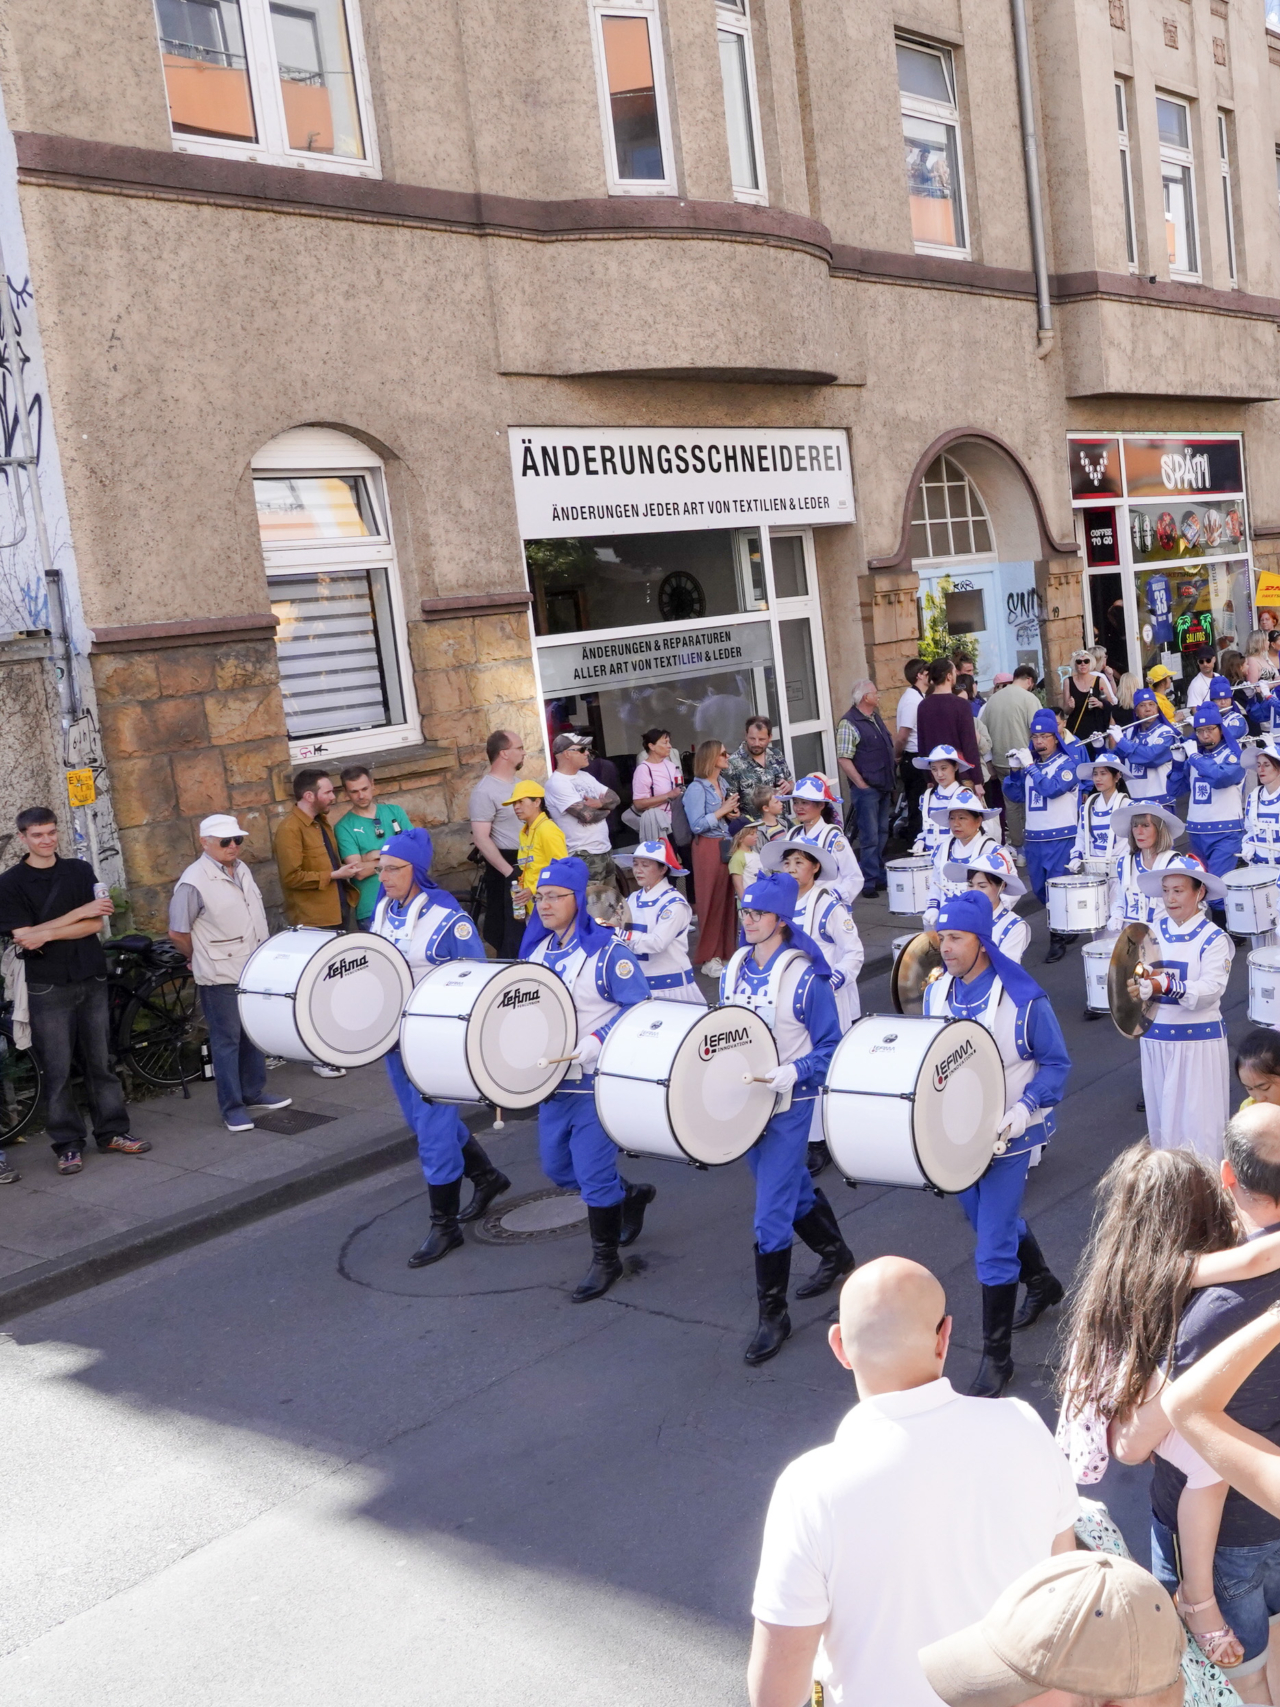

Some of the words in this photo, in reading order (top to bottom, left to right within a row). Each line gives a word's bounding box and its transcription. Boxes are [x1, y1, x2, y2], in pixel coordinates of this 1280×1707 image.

[522, 438, 842, 477] ÄNDERUNGSSCHNEIDEREI
[1160, 447, 1212, 490] SPÄTI
[552, 504, 640, 522] ÄNDERUNGEN
[642, 502, 680, 517] JEDER
[683, 501, 704, 516] ART
[708, 500, 731, 514] VON
[732, 498, 787, 512] TEXTILIEN
[789, 497, 796, 511] &
[798, 496, 830, 510] LEDER
[1090, 528, 1112, 537] COFFEE
[1092, 537, 1102, 546] TO
[1103, 536, 1113, 544] GO
[1154, 590, 1168, 614] 33
[582, 640, 652, 660] ÄNDERUNGEN
[654, 640, 661, 651] &
[663, 631, 732, 650] REPARATUREN
[1186, 632, 1206, 644] SALITOS
[574, 664, 607, 680] ALLER
[610, 662, 629, 676] ART
[632, 658, 652, 672] VON
[654, 652, 703, 669] TEXTILIEN
[704, 650, 712, 662] &
[713, 646, 742, 661] LEDER
[718, 1040, 749, 1052] INNOVATION
[949, 1052, 974, 1076] INNOVATION
